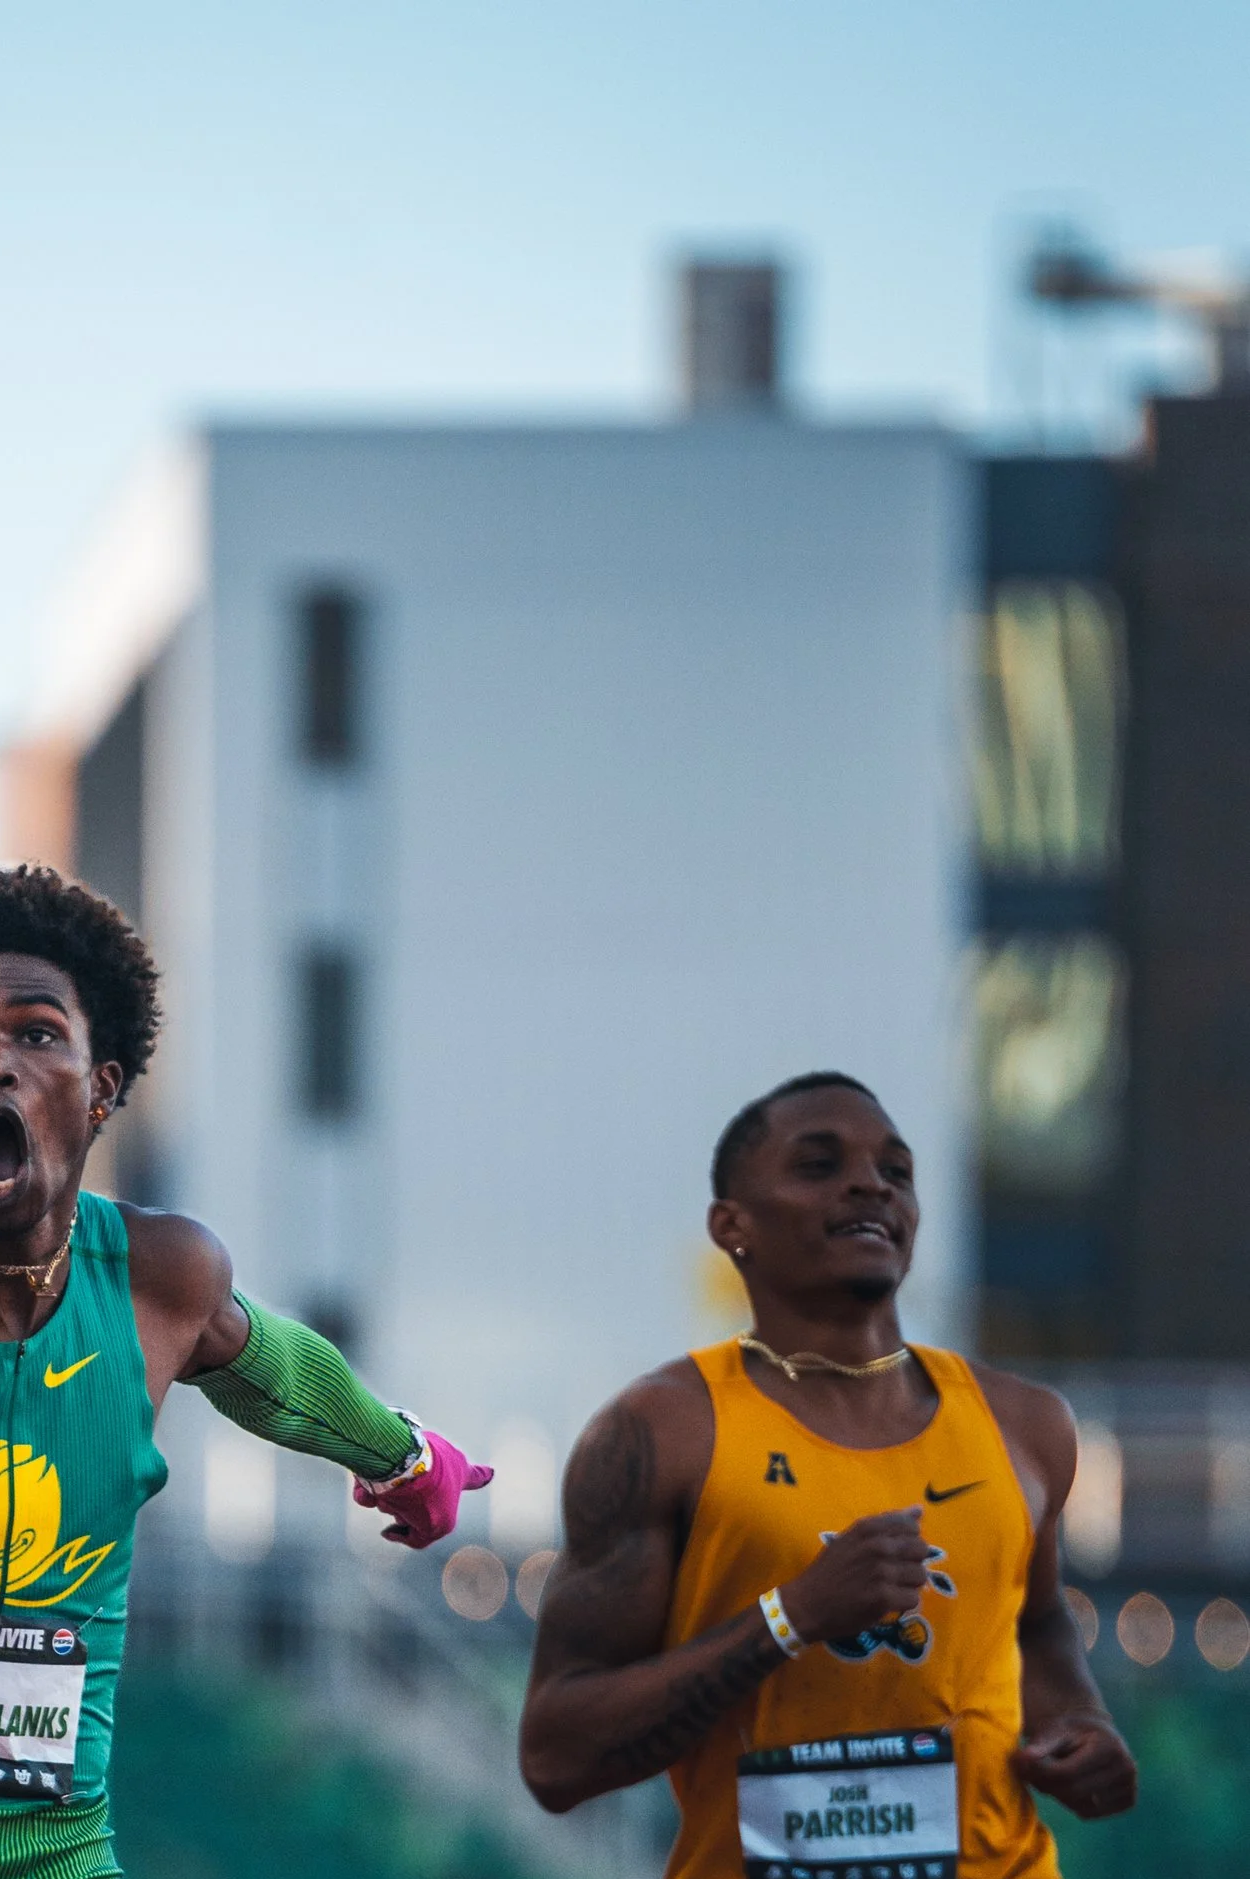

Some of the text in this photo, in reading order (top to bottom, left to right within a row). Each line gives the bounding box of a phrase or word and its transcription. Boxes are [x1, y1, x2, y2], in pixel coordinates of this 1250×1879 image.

[790, 1740, 843, 1764] TEAM
[828, 1784, 868, 1803] JOSH
[784, 1803, 915, 1840] PARRISH
